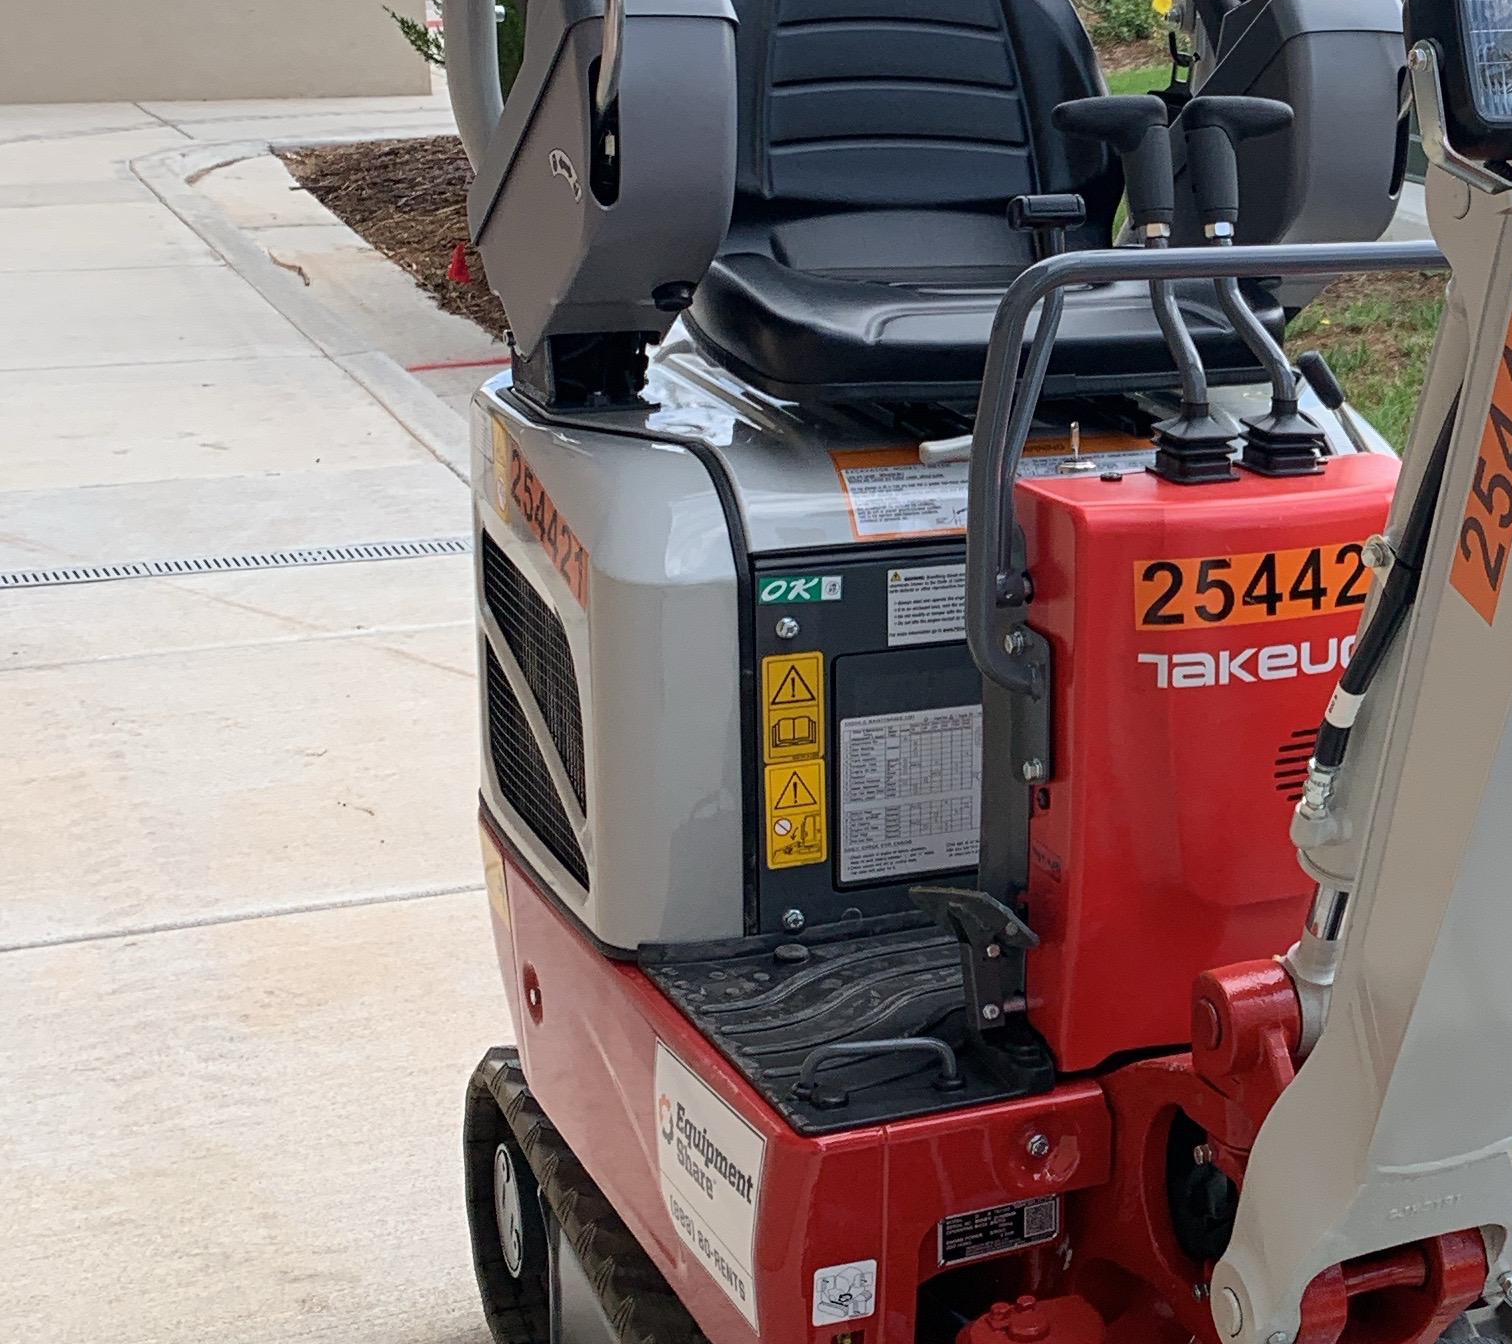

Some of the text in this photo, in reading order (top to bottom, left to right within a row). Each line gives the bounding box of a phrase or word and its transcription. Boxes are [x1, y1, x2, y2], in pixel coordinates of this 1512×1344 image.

[511, 448, 585, 602] 254421
[761, 578, 819, 601] OK
[676, 1101, 753, 1204] Equipment
[676, 1137, 714, 1200] Share
